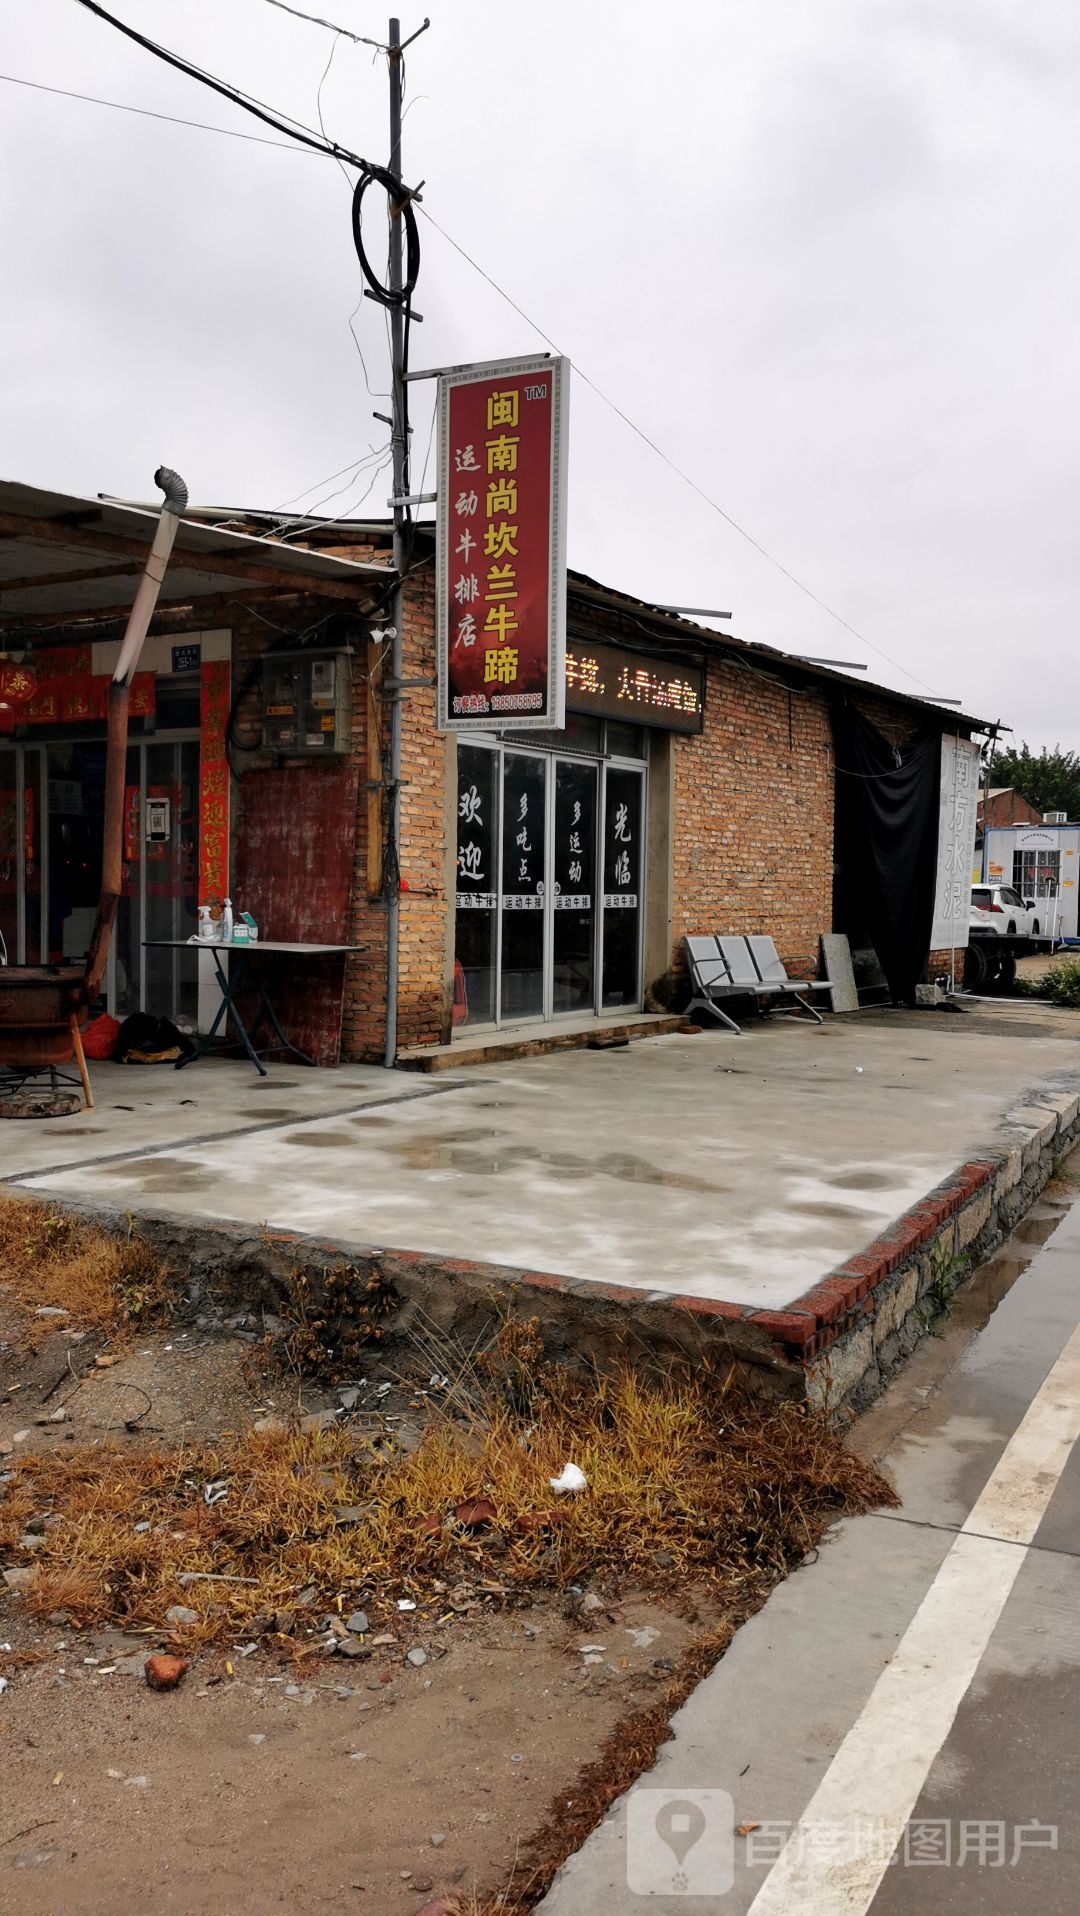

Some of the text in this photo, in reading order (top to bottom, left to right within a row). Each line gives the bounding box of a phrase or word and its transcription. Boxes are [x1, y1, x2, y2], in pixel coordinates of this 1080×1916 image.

[524, 384, 547, 400] TM
[454, 447, 481, 649] 运动牛排店
[484, 388, 520, 685] 闽南尚坎兰牛蹄
[458, 785, 485, 880] 欢迎
[515, 793, 532, 881] 多吃点
[568, 801, 583, 883] 多运动
[614, 803, 631, 885] 光临
[943, 744, 971, 919] 南方水泥
[505, 895, 542, 908] 运动牛排
[555, 896, 589, 908] 运动牛排
[605, 895, 635, 907] 运动牛排
